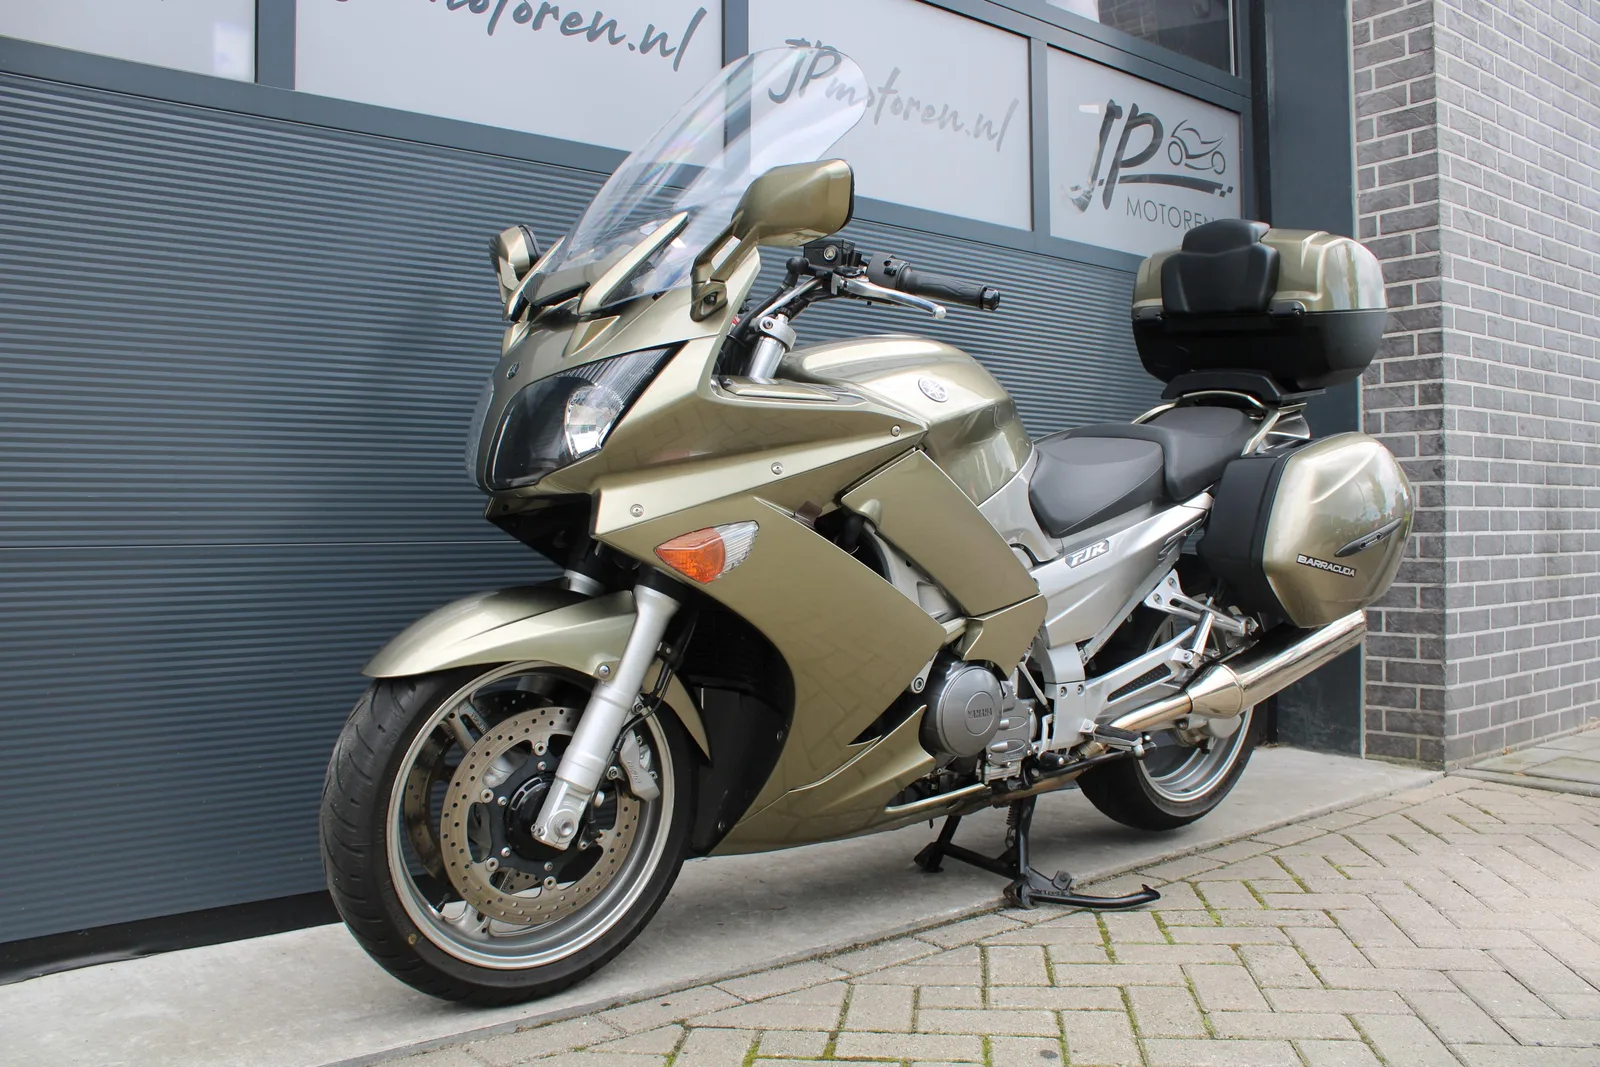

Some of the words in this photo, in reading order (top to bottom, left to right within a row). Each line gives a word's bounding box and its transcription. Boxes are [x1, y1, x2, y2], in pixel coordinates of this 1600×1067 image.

[1068, 99, 1164, 213] JP
[1070, 540, 1108, 568] FJR
[1297, 554, 1356, 577] BARRACUDA
[967, 707, 993, 719] YAMAHA
